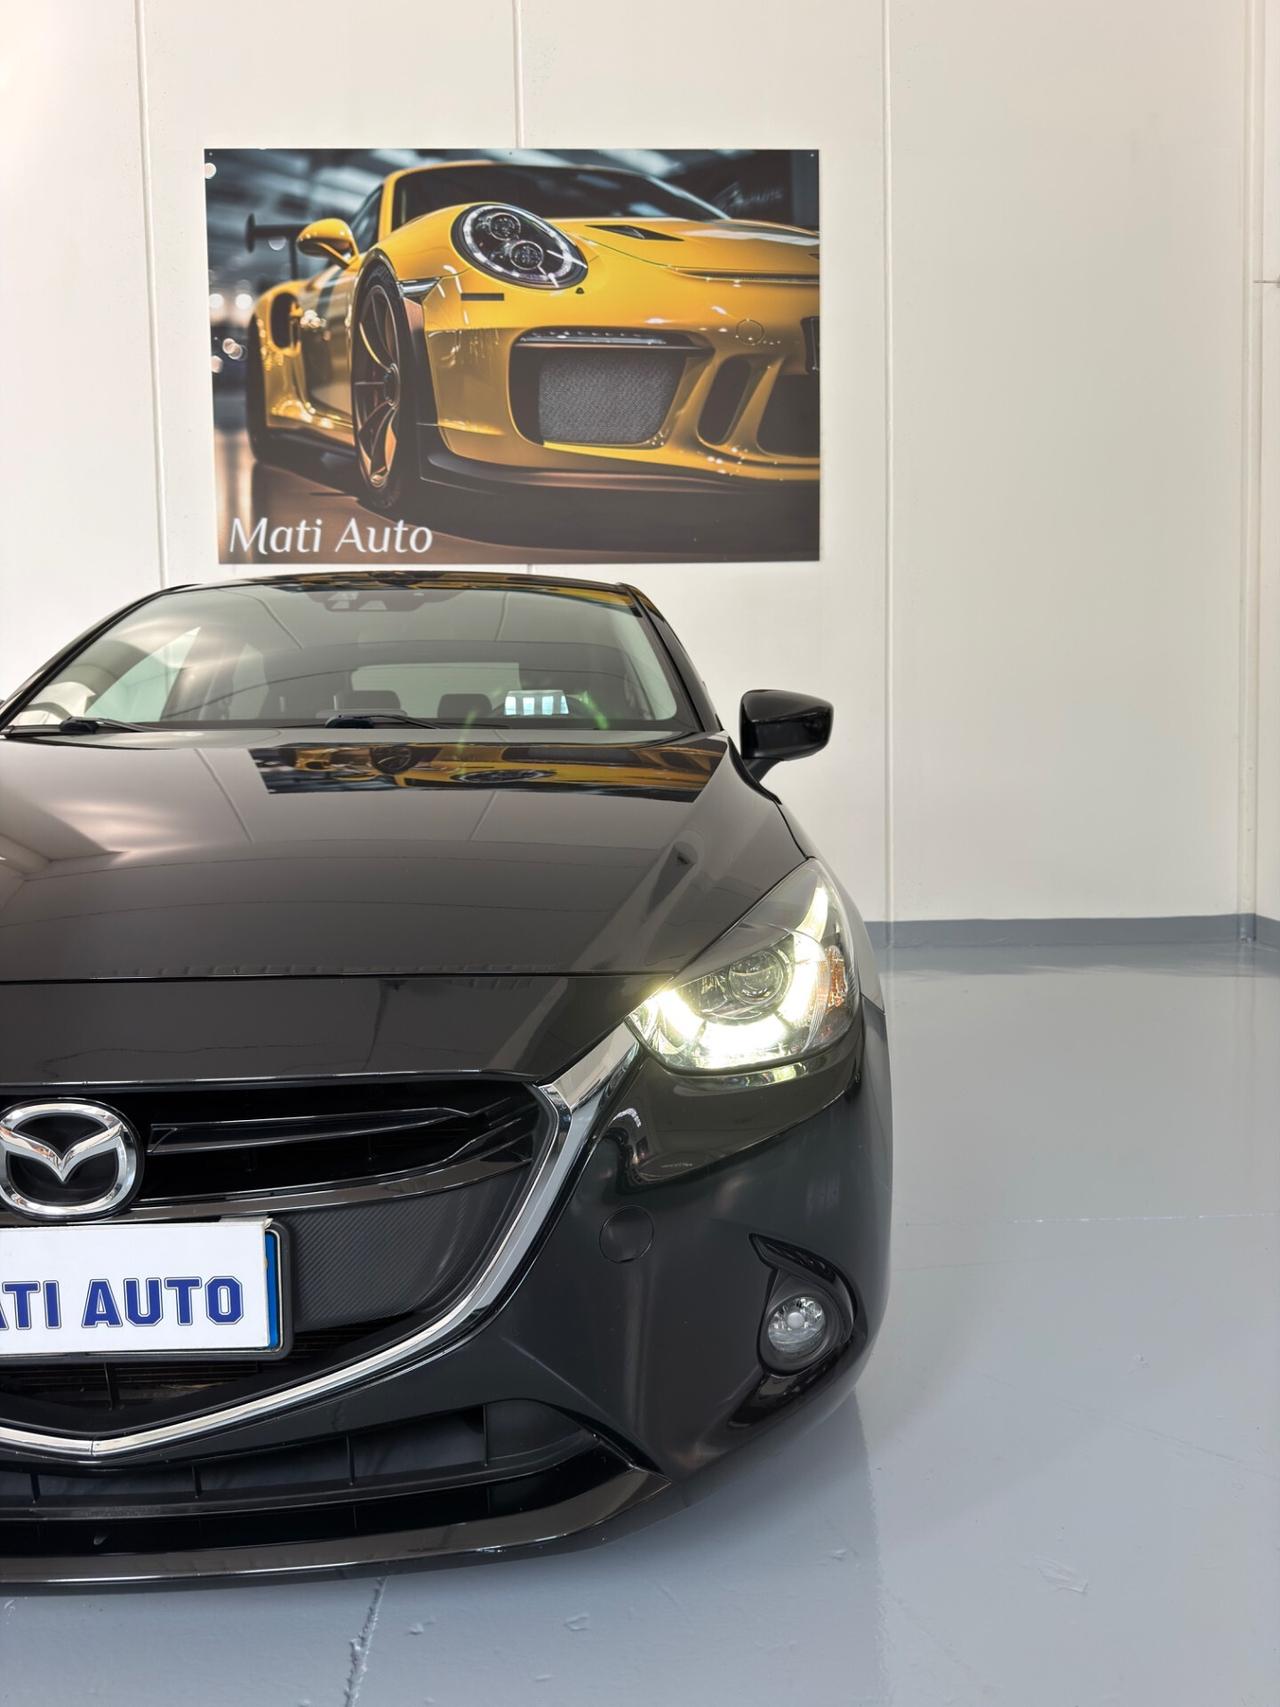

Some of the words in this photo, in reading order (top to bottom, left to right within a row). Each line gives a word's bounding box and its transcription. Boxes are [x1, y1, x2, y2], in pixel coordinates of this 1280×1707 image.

[230, 517, 322, 554] Mati
[335, 517, 433, 553] Auto
[0, 1280, 62, 1330] TI
[81, 1276, 244, 1328] AUTO
